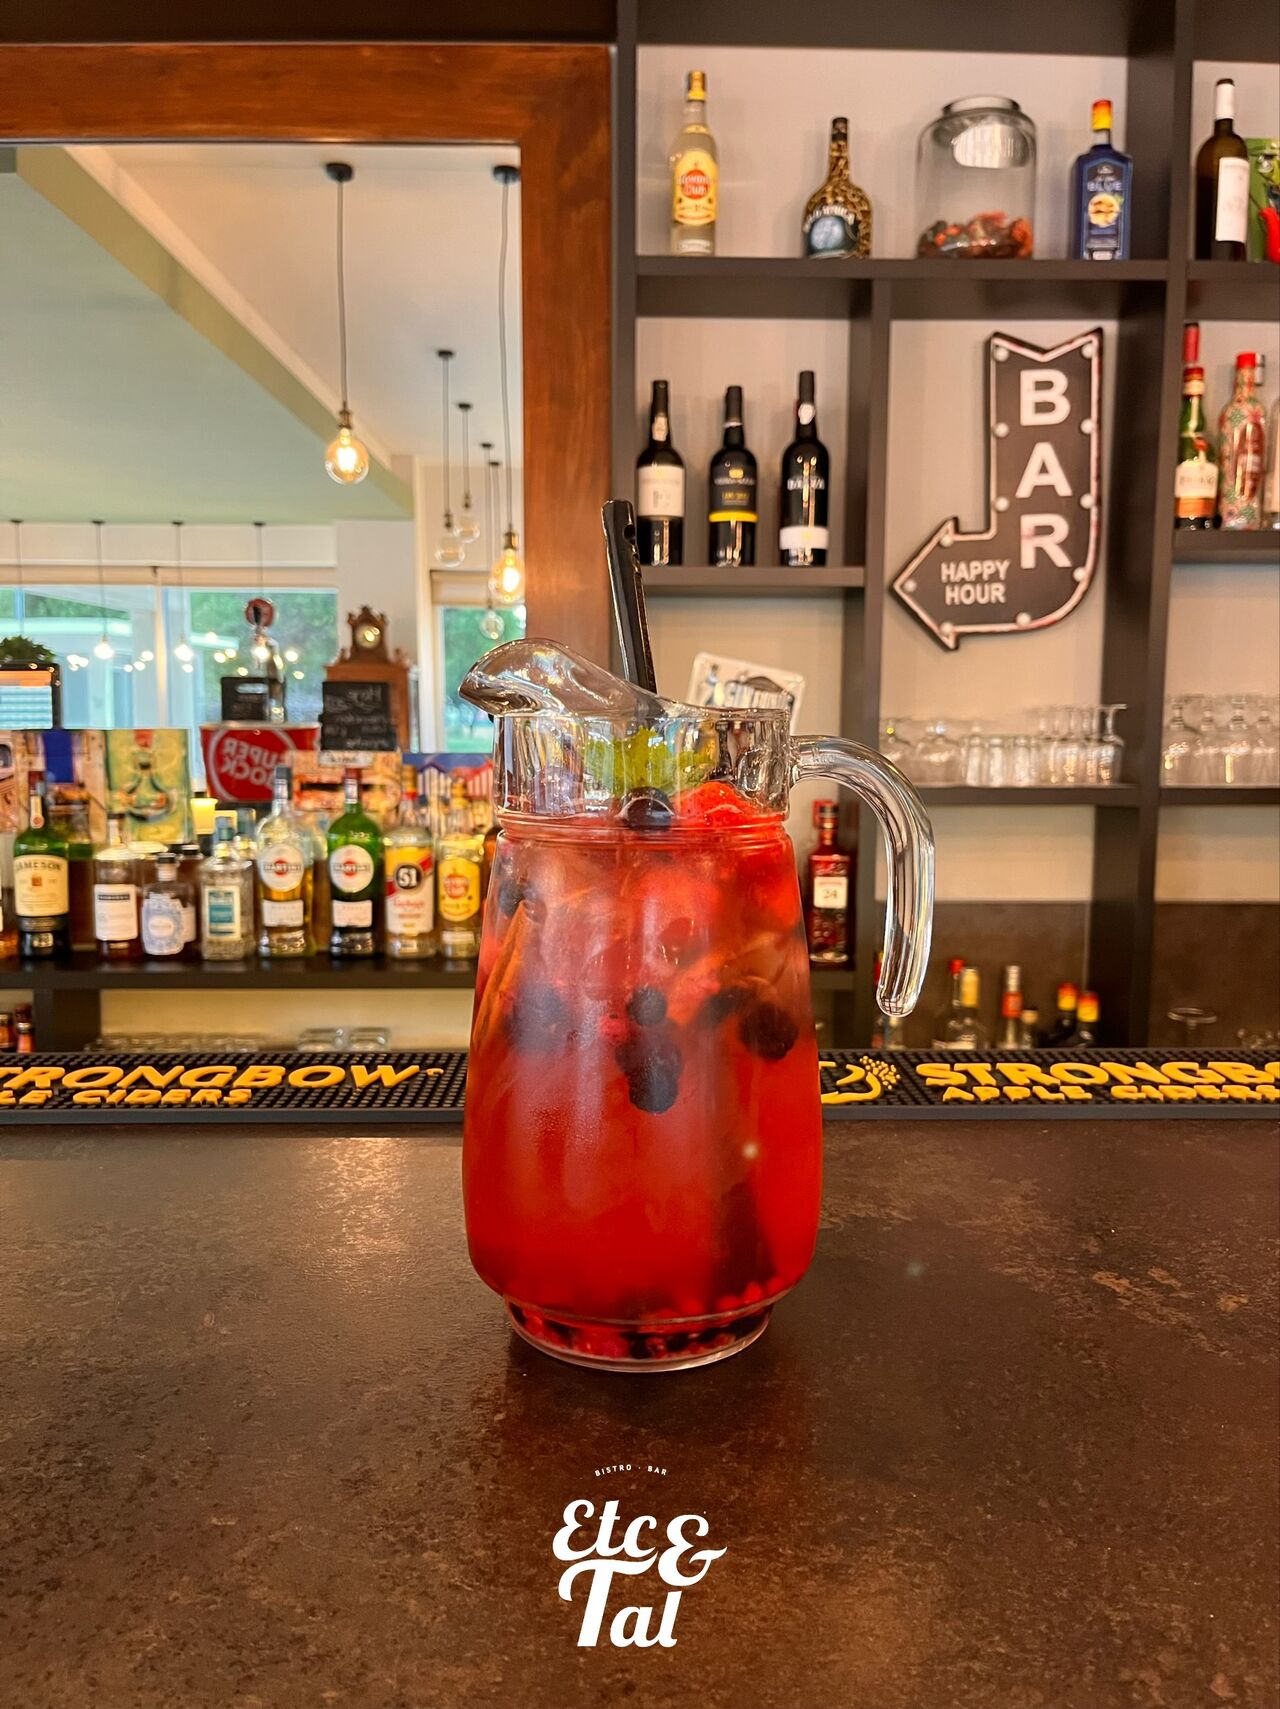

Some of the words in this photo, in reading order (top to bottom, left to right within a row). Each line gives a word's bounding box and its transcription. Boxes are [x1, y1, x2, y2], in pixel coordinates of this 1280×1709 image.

[1015, 368, 1073, 570] BAR
[941, 560, 1011, 583] HAPPY
[945, 583, 1006, 605] HOUR
[398, 867, 418, 888] 51
[73, 1088, 252, 1105] CIDERS
[942, 1085, 1093, 1102] APPLE
[1110, 1084, 1280, 1102] CIDERS
